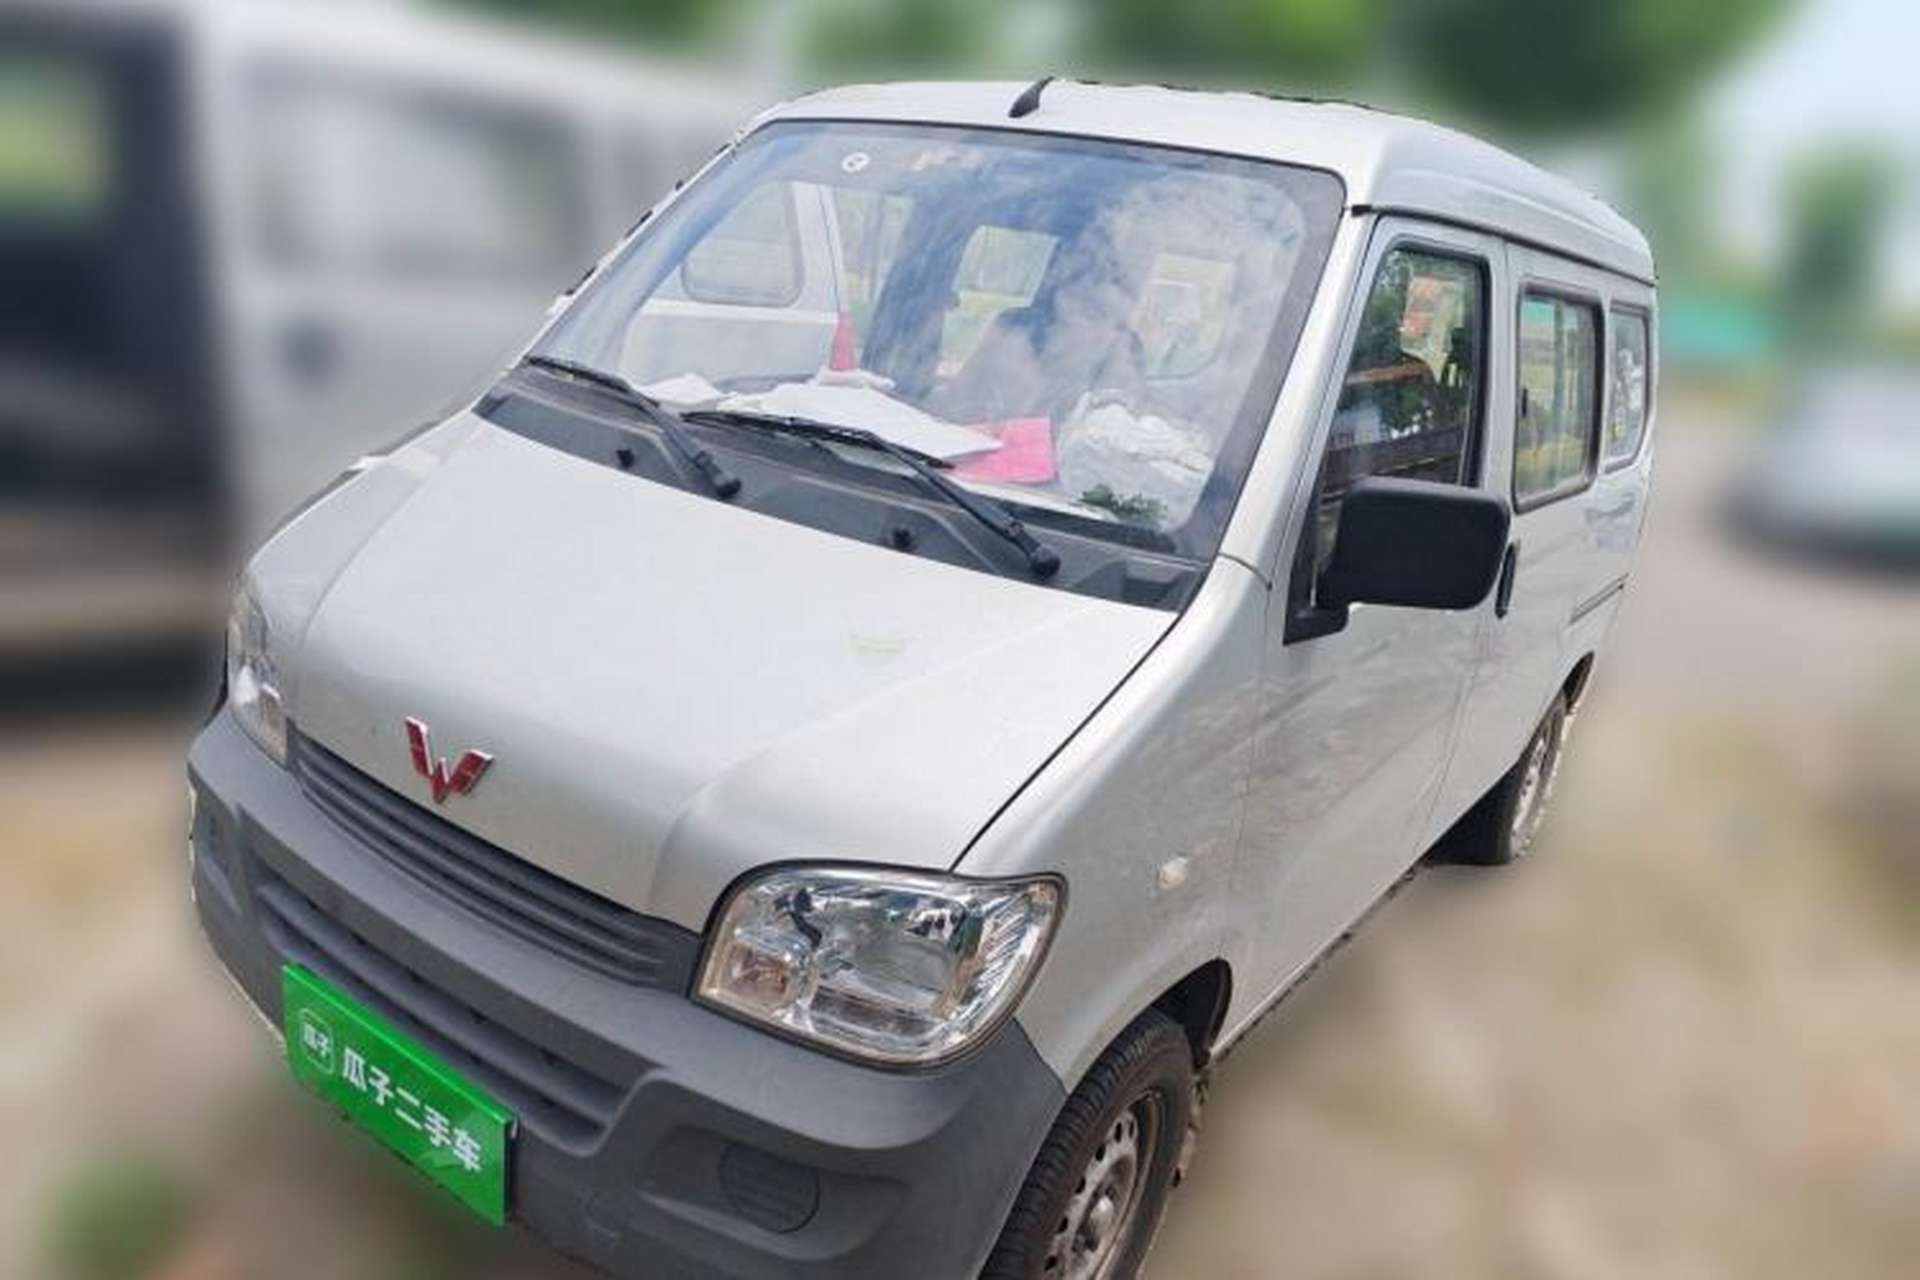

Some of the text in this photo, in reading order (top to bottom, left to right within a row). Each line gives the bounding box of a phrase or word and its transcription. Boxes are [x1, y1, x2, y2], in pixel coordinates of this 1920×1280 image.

[342, 1046, 481, 1172] 瓜子二手车
